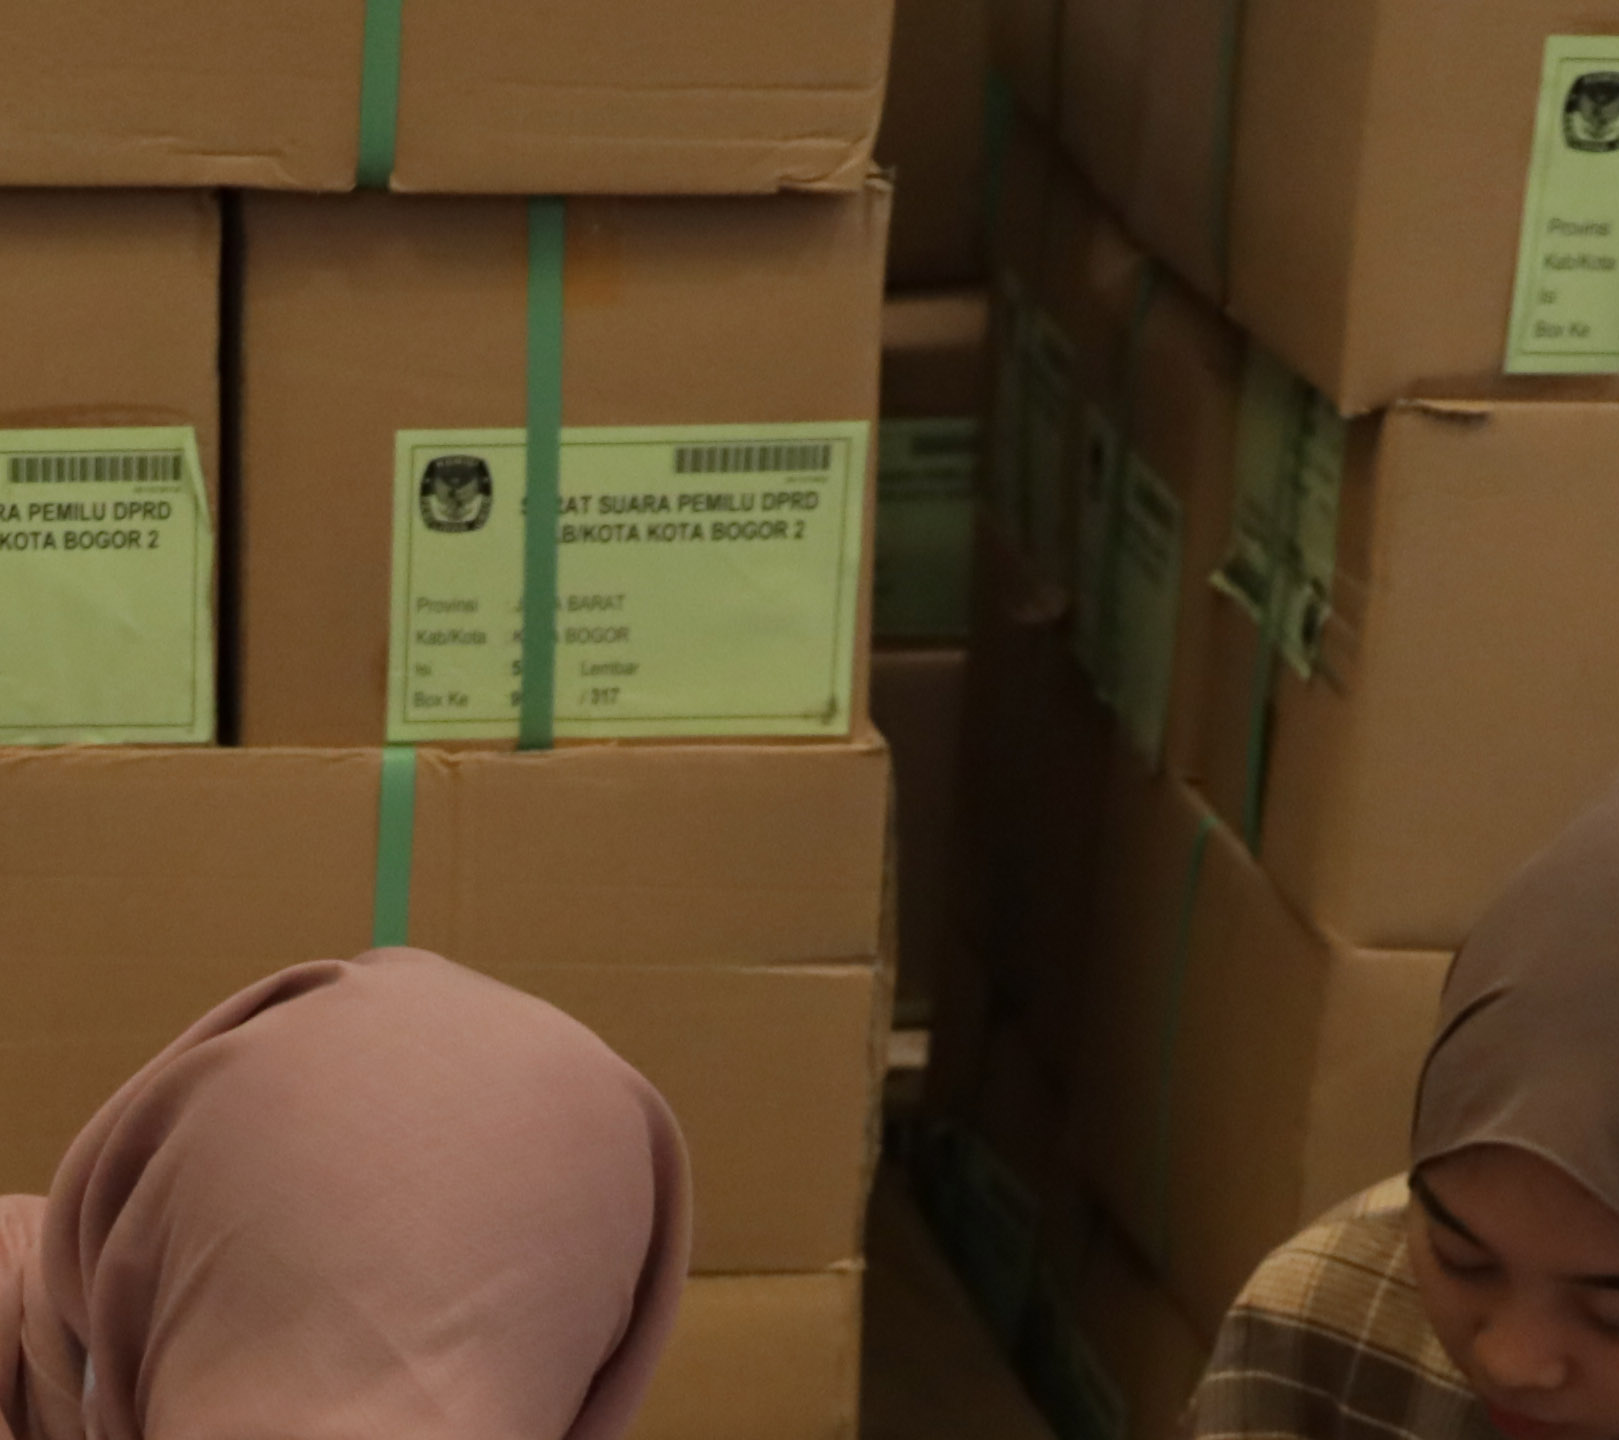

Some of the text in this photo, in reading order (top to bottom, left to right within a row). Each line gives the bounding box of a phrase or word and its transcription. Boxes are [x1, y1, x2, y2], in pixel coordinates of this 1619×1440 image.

[29, 503, 106, 522] PEMILU
[114, 502, 171, 520] DPRD
[600, 491, 820, 514] SUARA PEMILU DPRD
[0, 532, 56, 550] KOTA
[65, 531, 140, 549] BOGOR
[148, 530, 159, 549] 2
[647, 521, 805, 542] KOTA BOGOR 2
